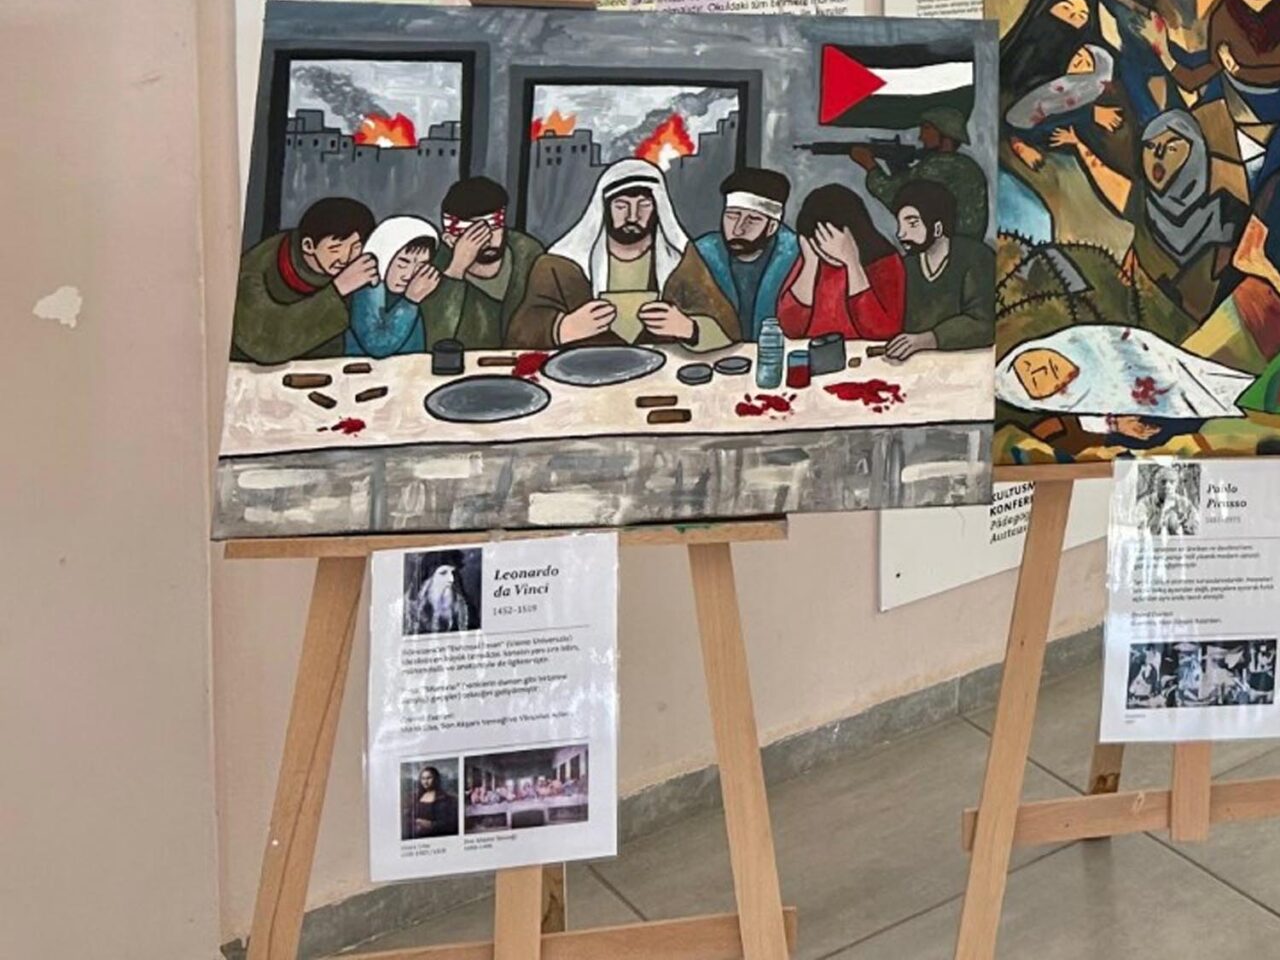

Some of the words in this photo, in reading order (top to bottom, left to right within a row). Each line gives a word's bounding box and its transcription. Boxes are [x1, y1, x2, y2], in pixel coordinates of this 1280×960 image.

[494, 564, 559, 581] Leonardo
[493, 585, 511, 598] da
[515, 582, 549, 595] Vinci
